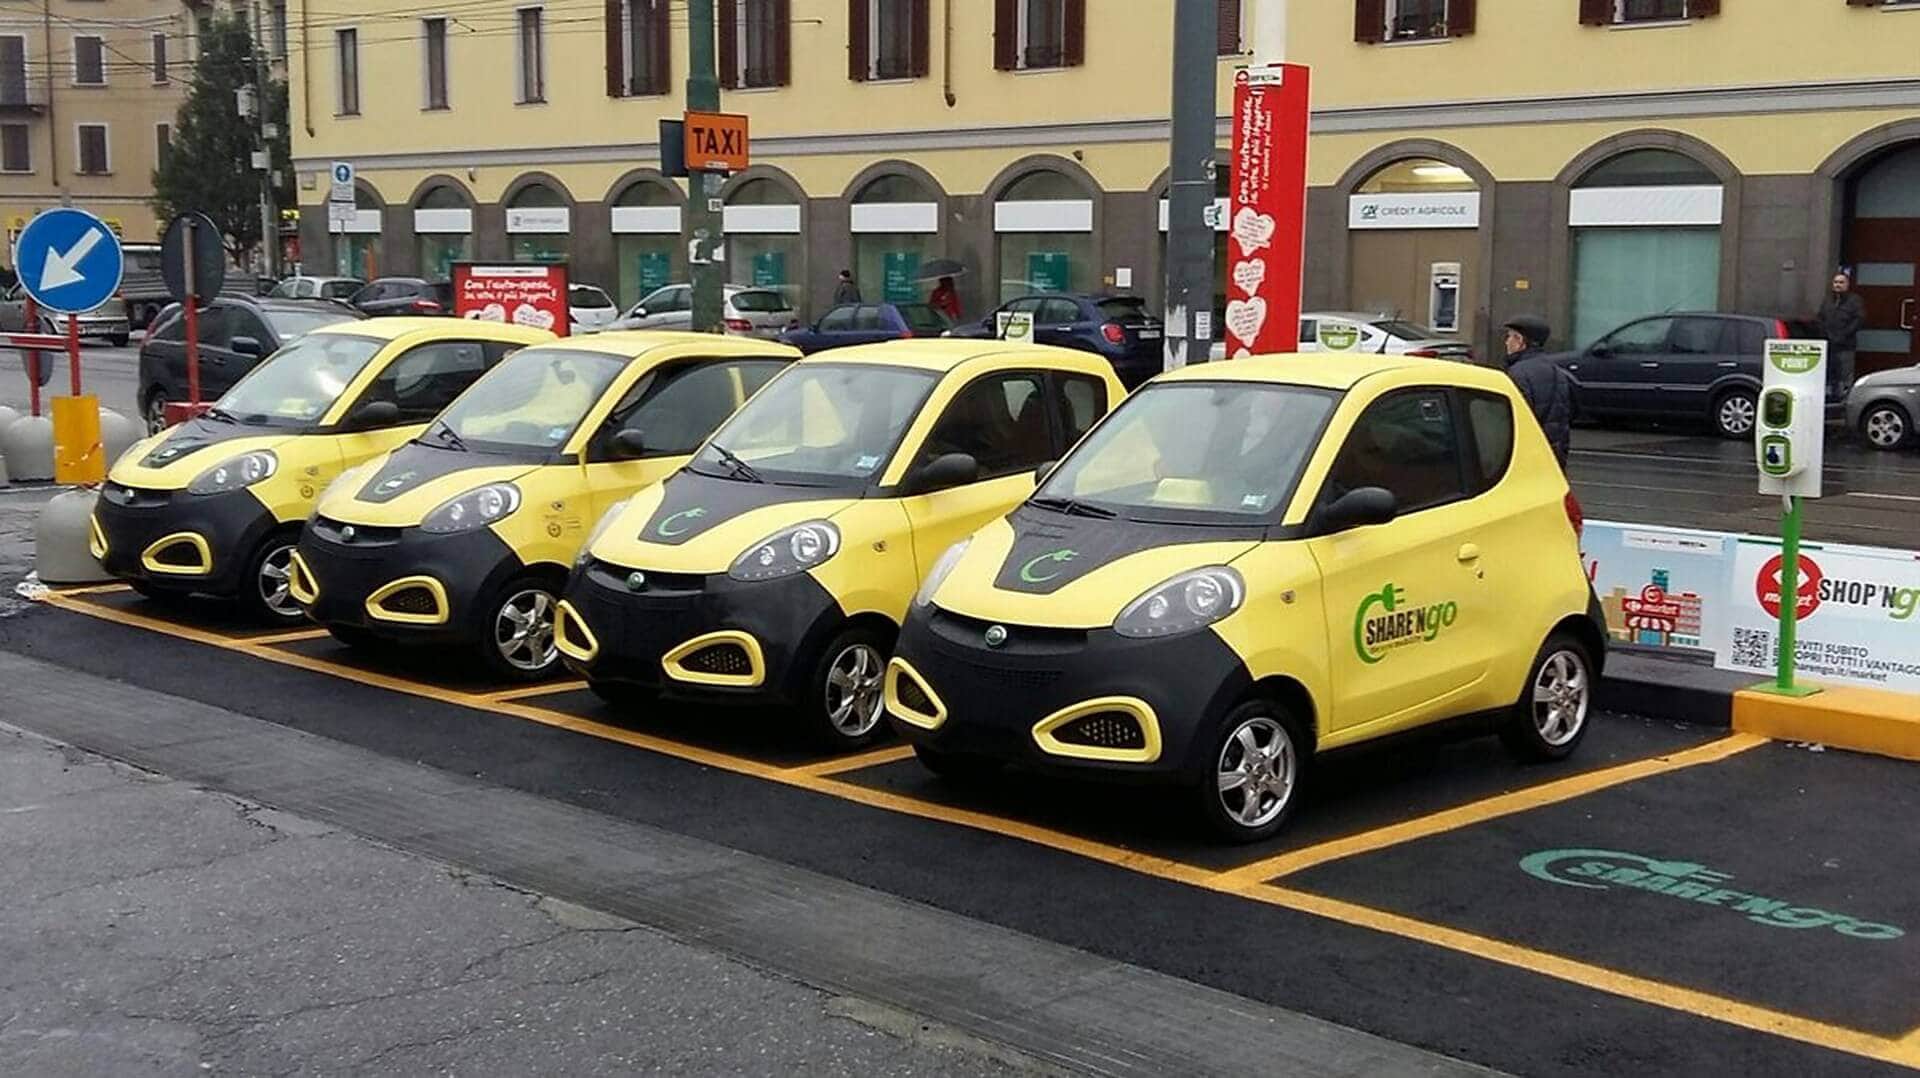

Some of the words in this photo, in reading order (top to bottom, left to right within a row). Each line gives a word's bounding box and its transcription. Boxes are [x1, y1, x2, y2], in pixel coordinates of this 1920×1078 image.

[693, 128, 742, 155] TAXI
[1418, 205, 1467, 216] AGRICOLE
[1781, 358, 1809, 369] POINT
[1824, 643, 1869, 658] SUBITO
[1824, 653, 1858, 667] TUTTI
